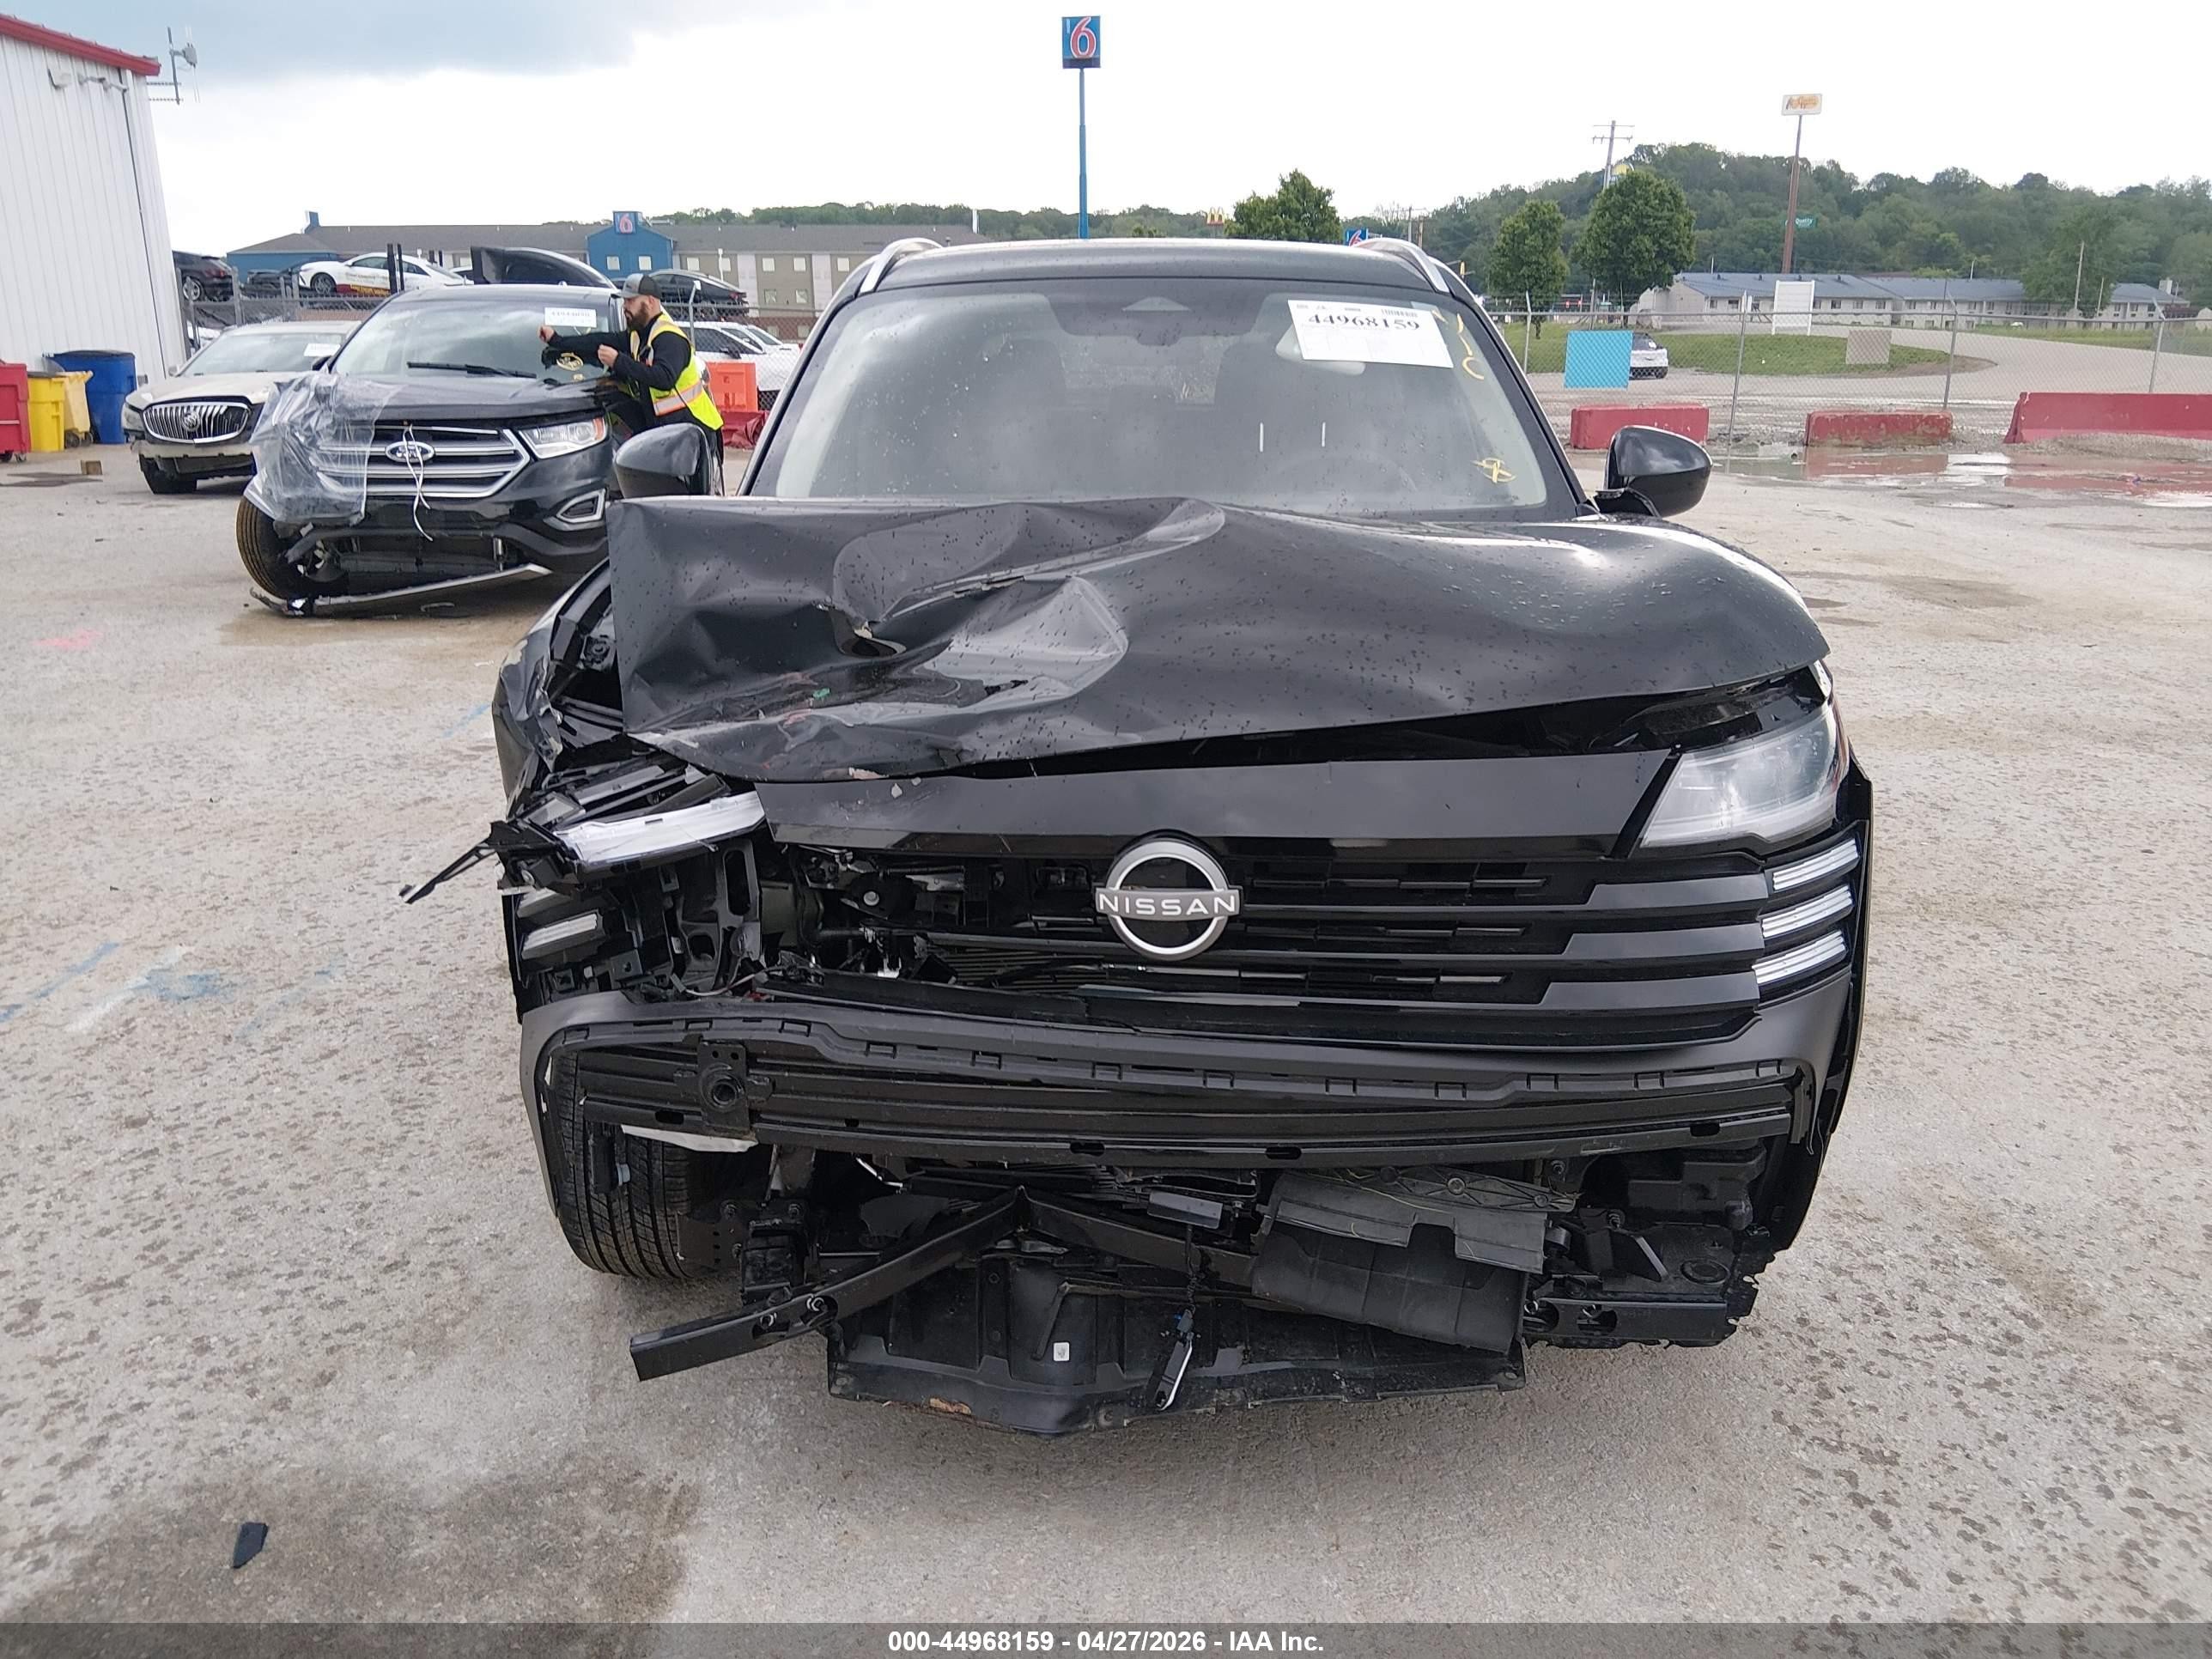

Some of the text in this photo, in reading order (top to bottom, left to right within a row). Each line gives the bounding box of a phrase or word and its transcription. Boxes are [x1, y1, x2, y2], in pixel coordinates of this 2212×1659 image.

[1070, 16, 1097, 58] 6
[1309, 313, 1420, 330] 44968159
[1098, 893, 1235, 916] NISSAN
